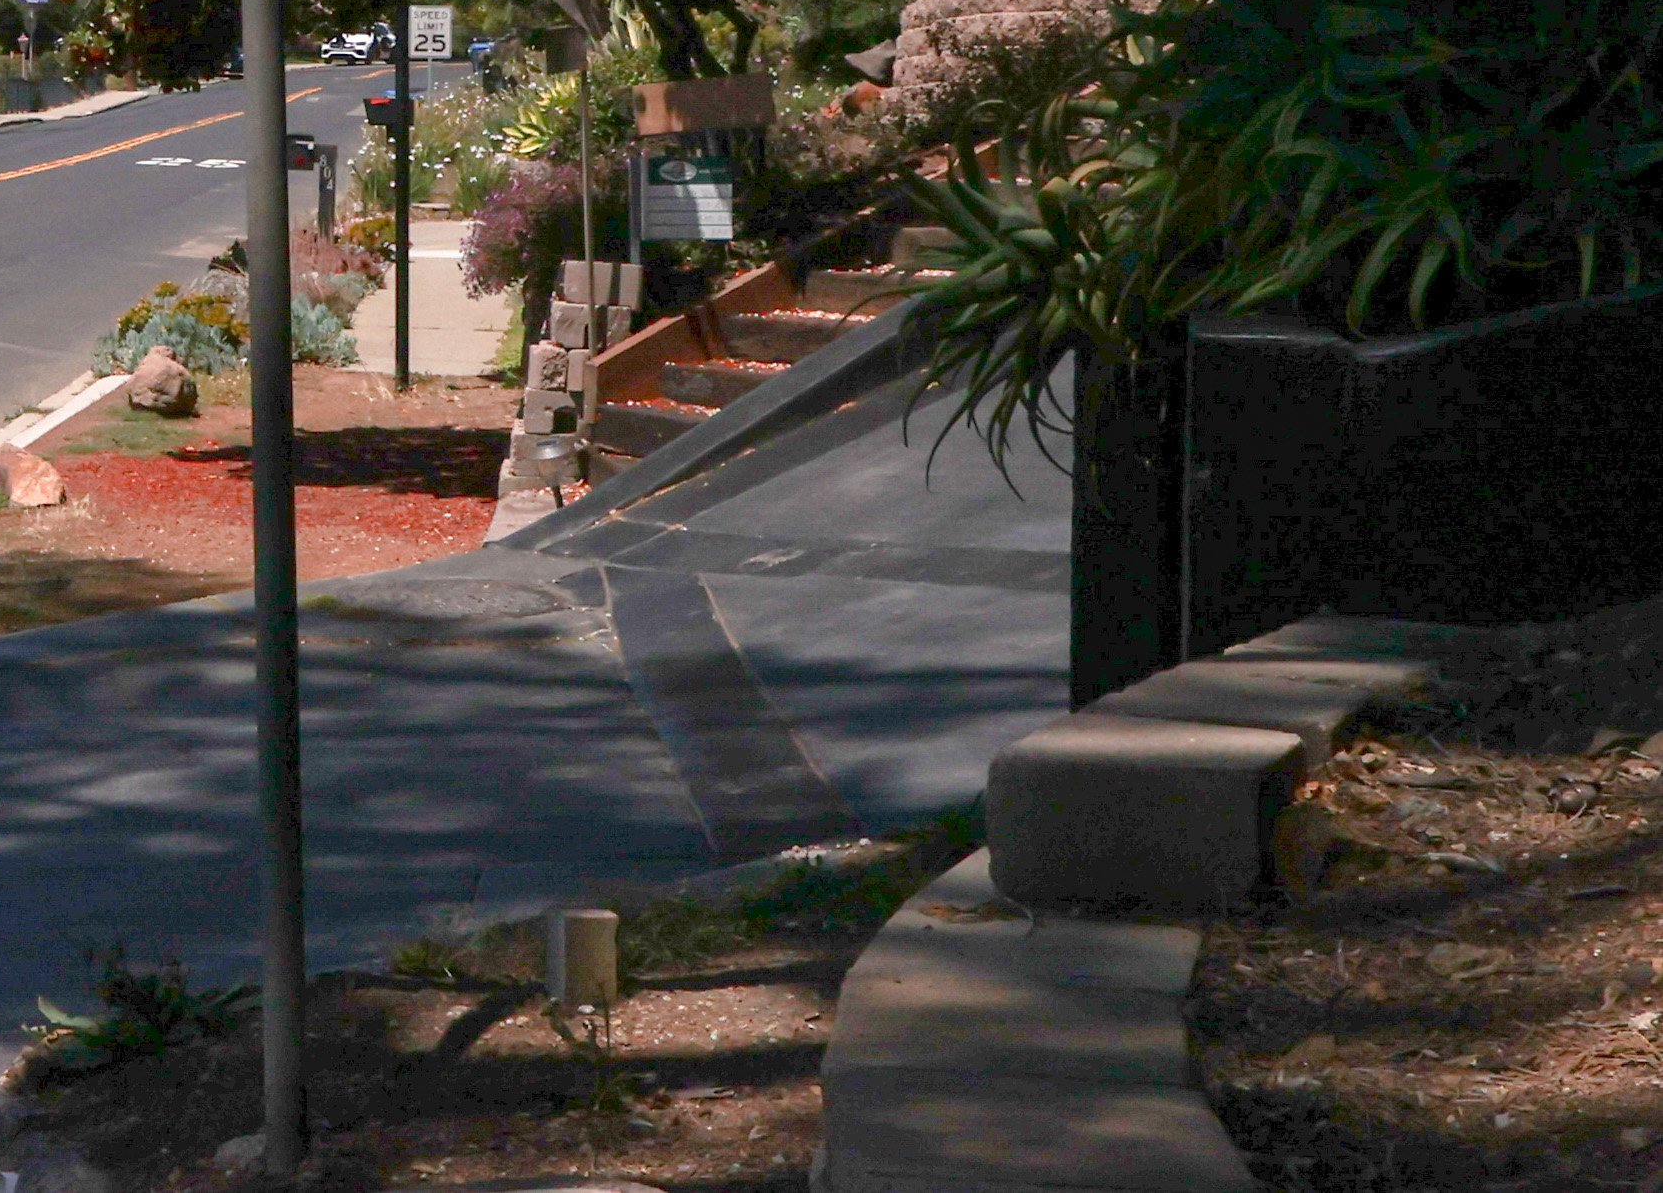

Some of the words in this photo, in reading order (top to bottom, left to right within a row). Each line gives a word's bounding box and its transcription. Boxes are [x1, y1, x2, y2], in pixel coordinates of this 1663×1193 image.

[413, 10, 449, 20] SPEED
[417, 22, 445, 31] LIMIT
[414, 33, 446, 52] 25
[135, 157, 247, 169] 25
[319, 154, 334, 190] 804
